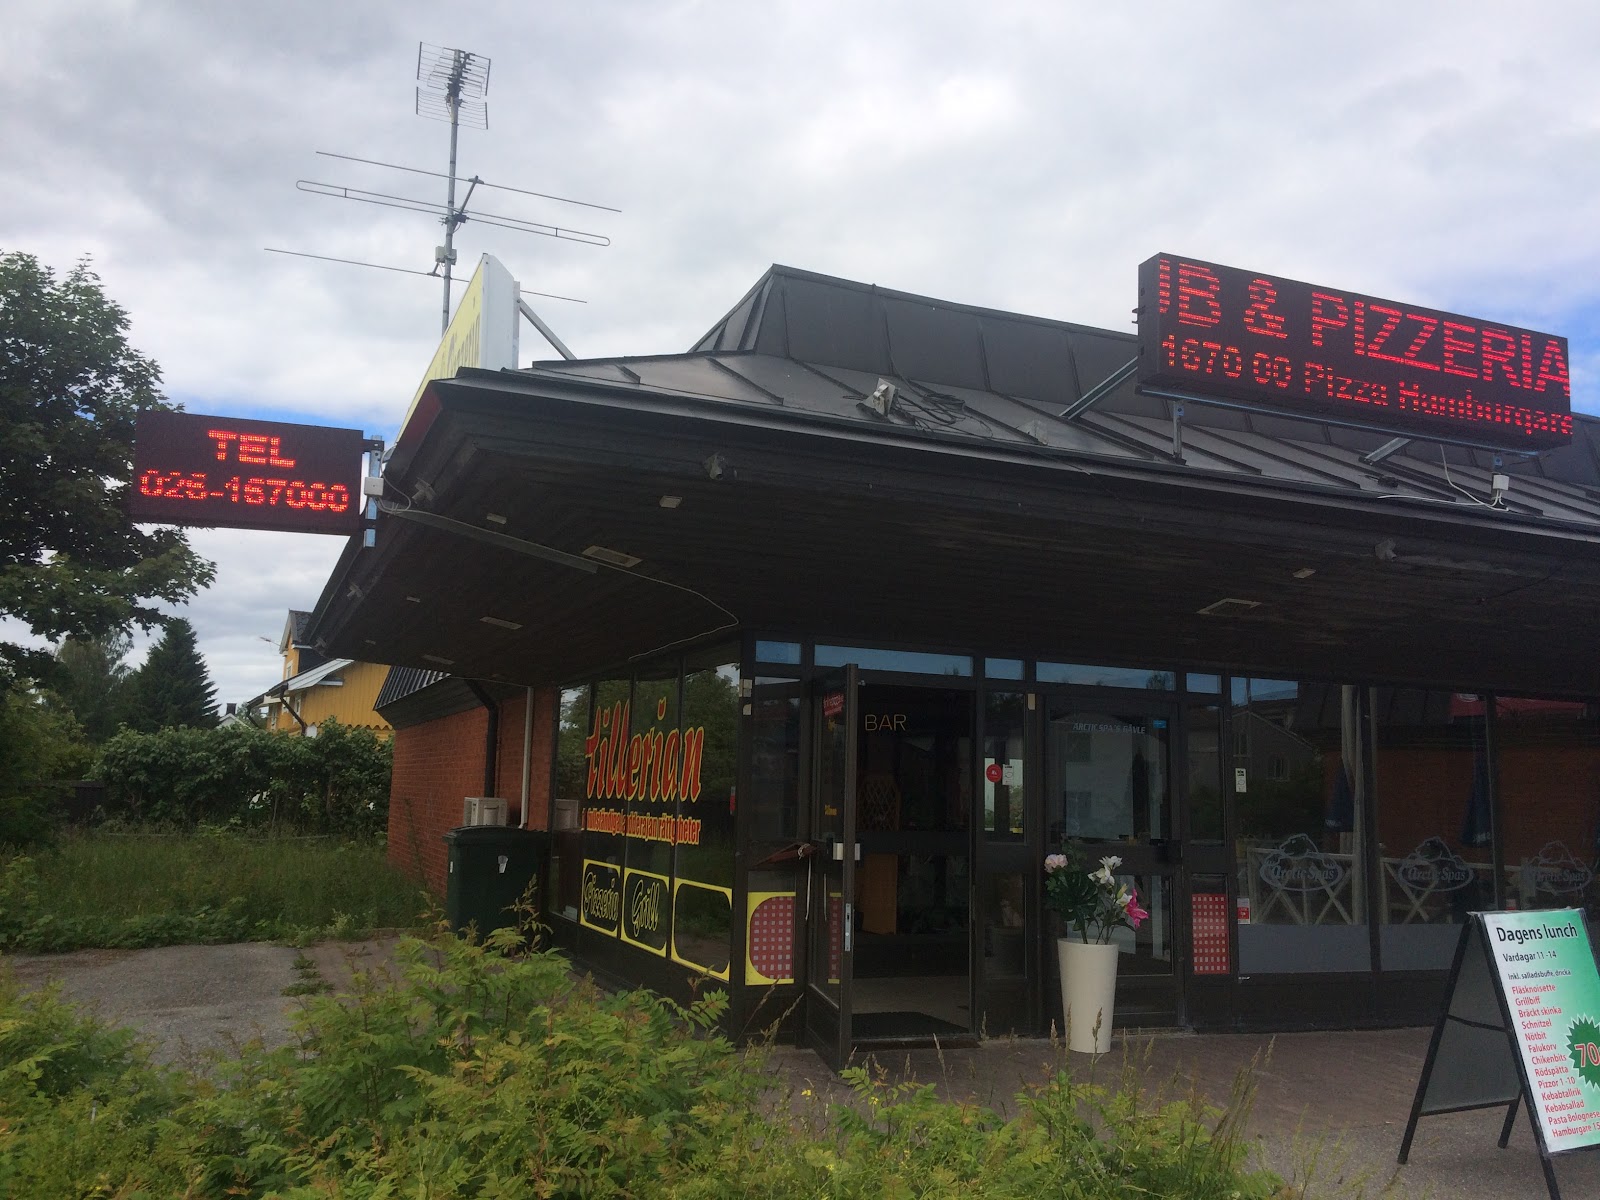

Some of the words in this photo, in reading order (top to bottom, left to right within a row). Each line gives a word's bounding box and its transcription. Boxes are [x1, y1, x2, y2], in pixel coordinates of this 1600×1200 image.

[1244, 278, 1288, 339] &
[1312, 291, 1570, 397] PIZZERIA
[1162, 334, 1242, 378] 1670
[1253, 351, 1292, 388] 00
[1305, 361, 1388, 406] Pizza
[208, 429, 296, 468] TEL
[139, 469, 349, 512] 026-167000
[864, 713, 907, 731] BAR
[585, 696, 704, 802] tillerian
[1308, 865, 1335, 881] Spas
[1441, 866, 1466, 883] Spas
[632, 879, 660, 937] Grill
[1496, 926, 1542, 944] Dagens
[1543, 922, 1577, 938] lunch
[1502, 952, 1536, 963] Vardagar
[1511, 984, 1556, 994] Fläsknoisette
[1515, 996, 1541, 1006] Grillbiff
[1518, 1008, 1540, 1018] Bräckt
[1541, 1006, 1562, 1015] skinka
[1522, 1019, 1552, 1029] Schnitzel
[1528, 1043, 1557, 1053] Falukorv
[1531, 1054, 1567, 1065] Chikenbits
[1535, 1066, 1569, 1077] Rödspätta
[1538, 1079, 1558, 1089] Pizzor
[1541, 1088, 1582, 1101] Kebabtallrik
[1545, 1099, 1585, 1113] Kebabsallad
[1548, 1115, 1568, 1126] Pasta
[1552, 1123, 1592, 1138] Hamburgare
